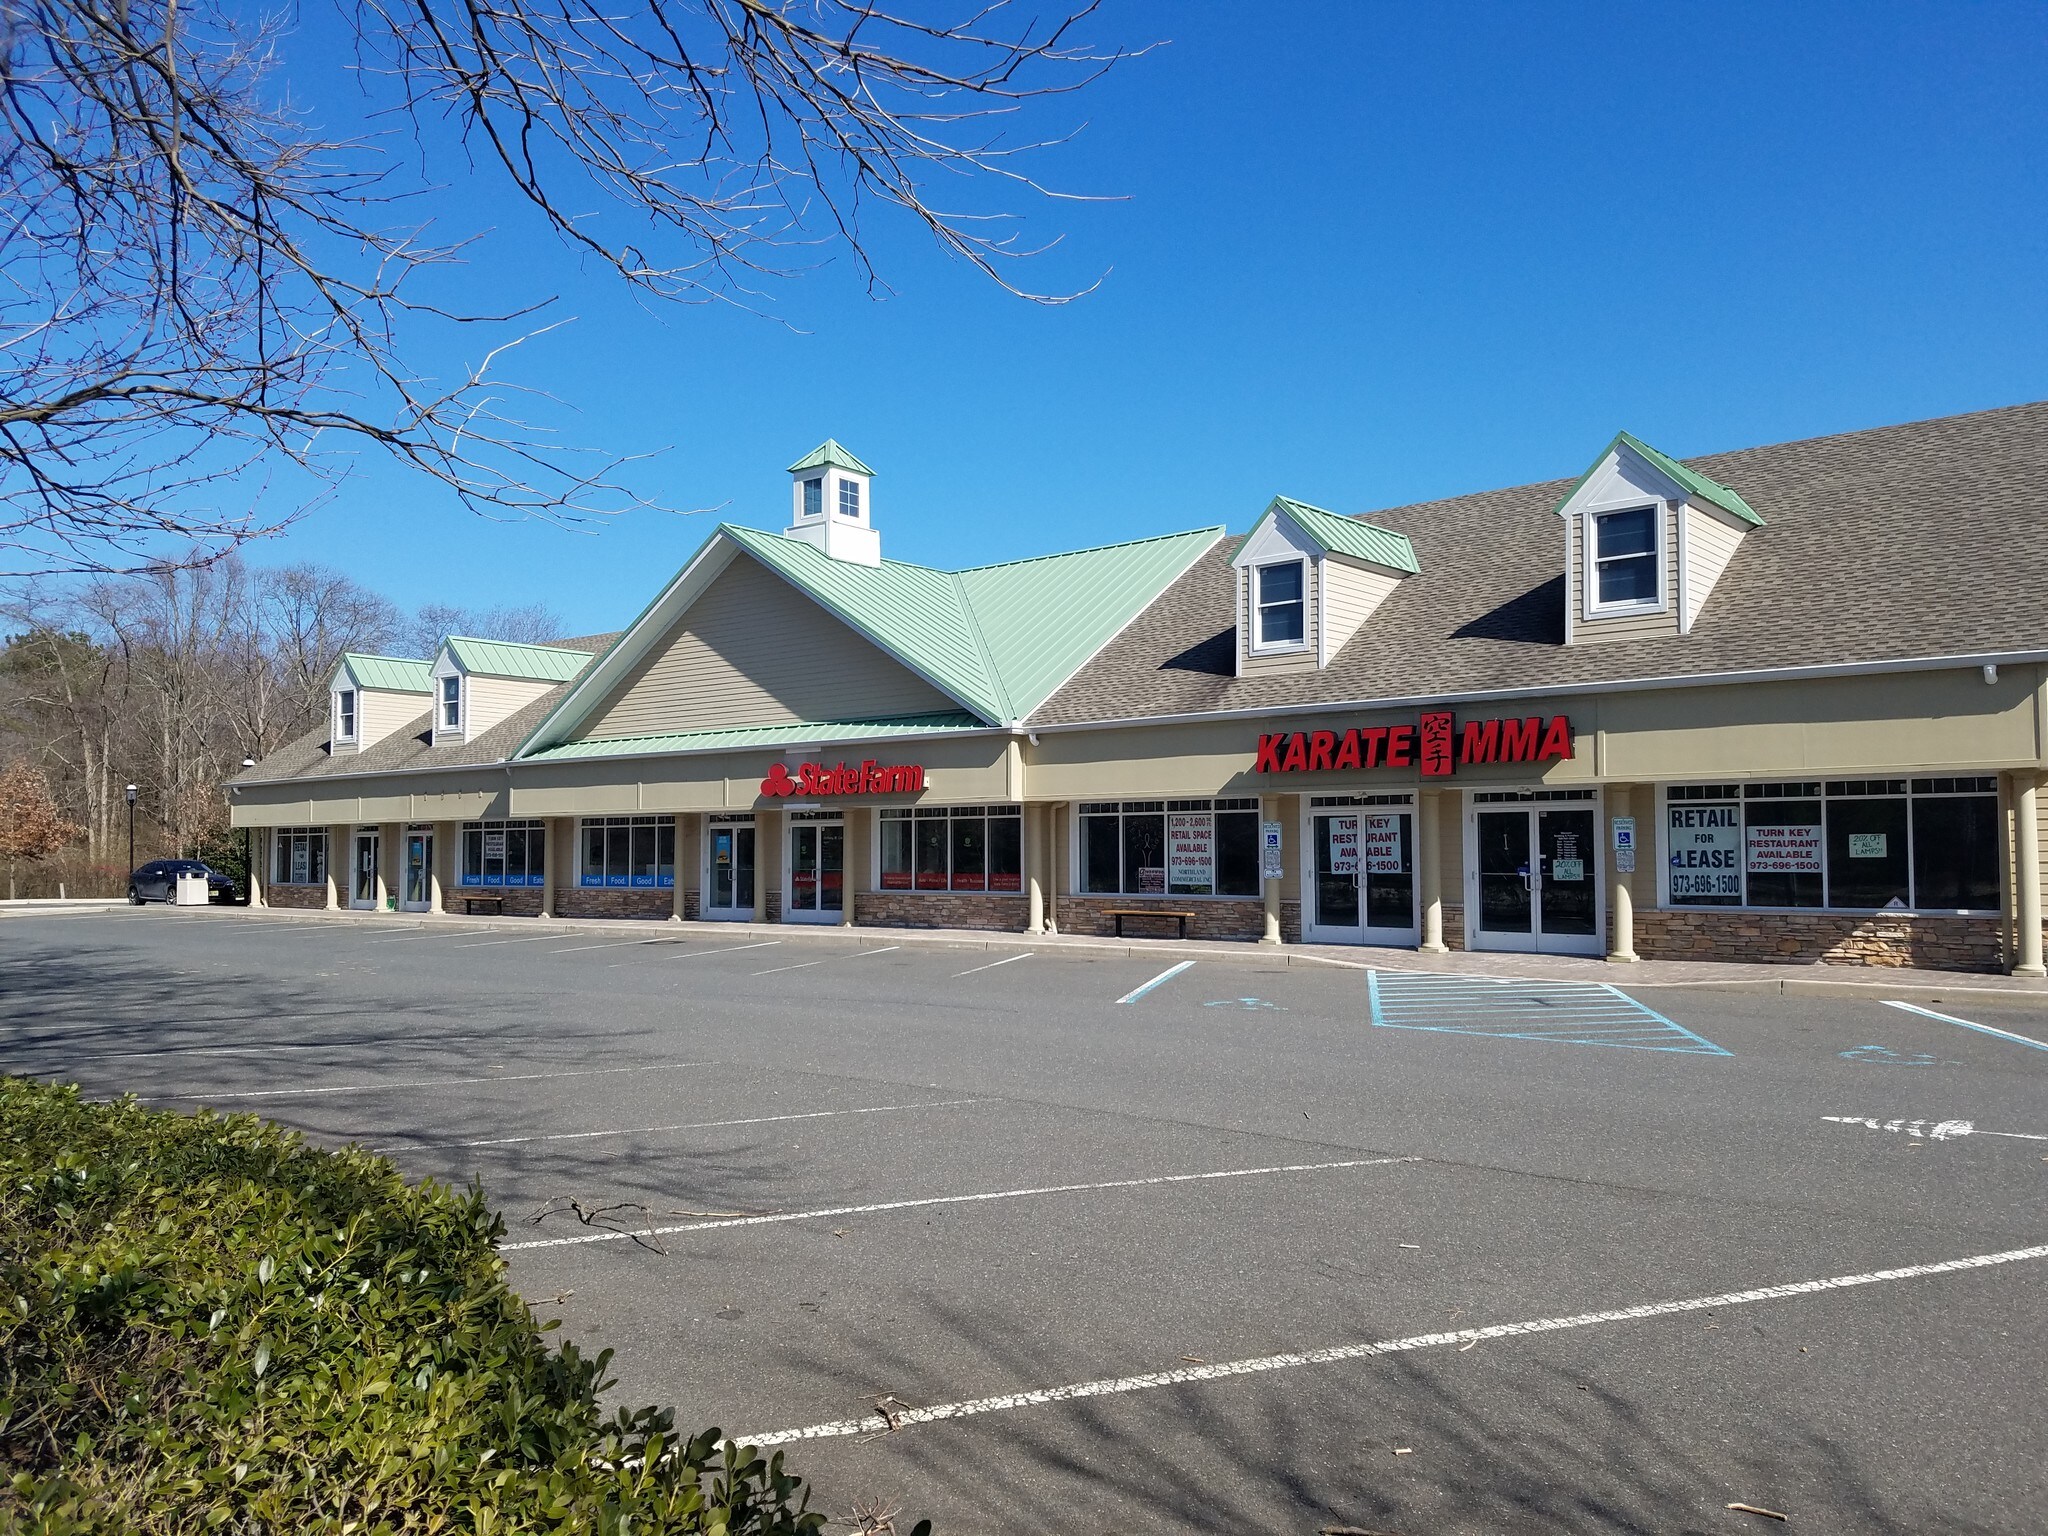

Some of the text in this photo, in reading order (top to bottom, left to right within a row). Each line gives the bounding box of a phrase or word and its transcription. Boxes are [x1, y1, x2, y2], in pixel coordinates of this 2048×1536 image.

[1256, 714, 1574, 773] KARATE MMA
[1671, 808, 1738, 828] RETAIL
[1338, 818, 1390, 830] TUR KEY
[1170, 830, 1212, 840] RETAIL SPACE
[1756, 828, 1811, 837] TURN KEY
[1332, 832, 1398, 844] RESTURANT
[1694, 833, 1714, 843] FOR
[1853, 834, 1869, 842] 20%
[1175, 843, 1208, 852] AVAILABLE
[1749, 839, 1819, 848] RESTAURANT
[1861, 841, 1873, 849] ALL
[1339, 846, 1393, 858] AVAABLE
[1756, 850, 1813, 859] AVAILABLE
[1171, 856, 1212, 866] 973-696-1500
[1675, 849, 1735, 868] LEASE
[1333, 860, 1399, 872] 973-66-1500
[1749, 861, 1820, 870] 973-696-1500
[466, 876, 480, 884] Fresh
[509, 876, 524, 884] Good
[586, 876, 602, 884] Fresh
[636, 877, 652, 885] Good
[1673, 874, 1739, 893] 973-696-1500
